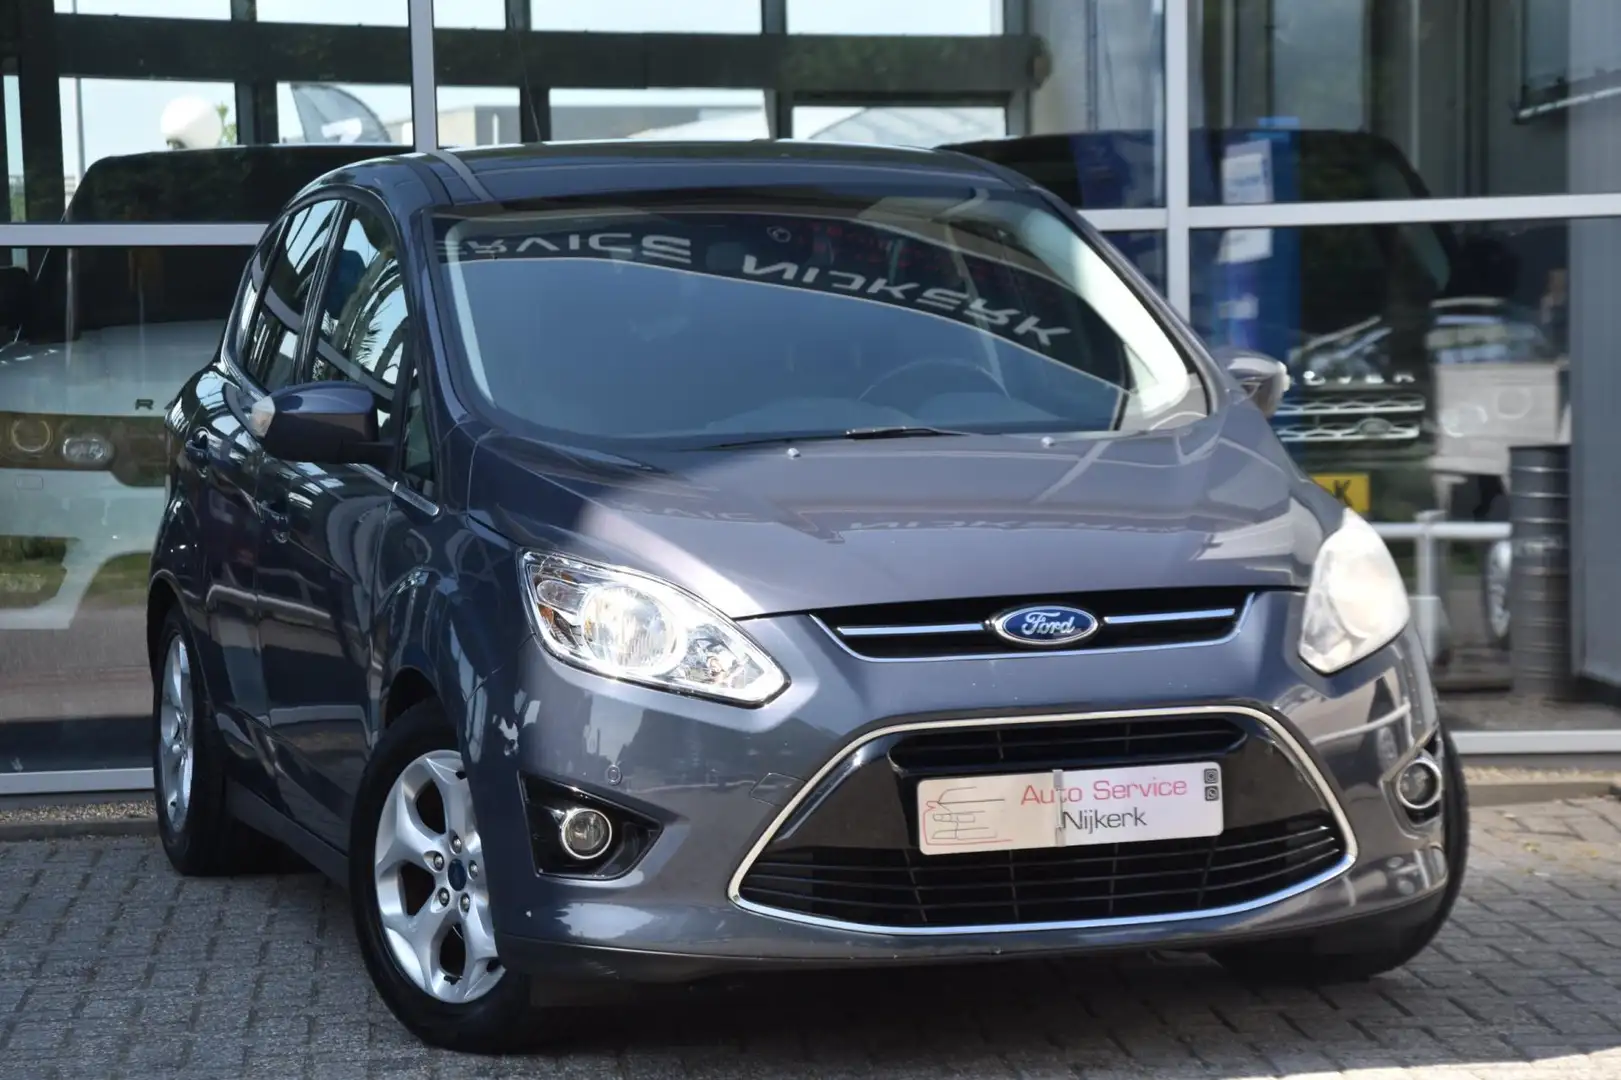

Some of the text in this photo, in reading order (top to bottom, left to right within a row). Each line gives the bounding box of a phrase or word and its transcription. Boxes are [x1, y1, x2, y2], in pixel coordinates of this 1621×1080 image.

[1021, 611, 1075, 635] Ford
[1093, 777, 1187, 801] Service
[1062, 807, 1147, 834] Nijkerk
